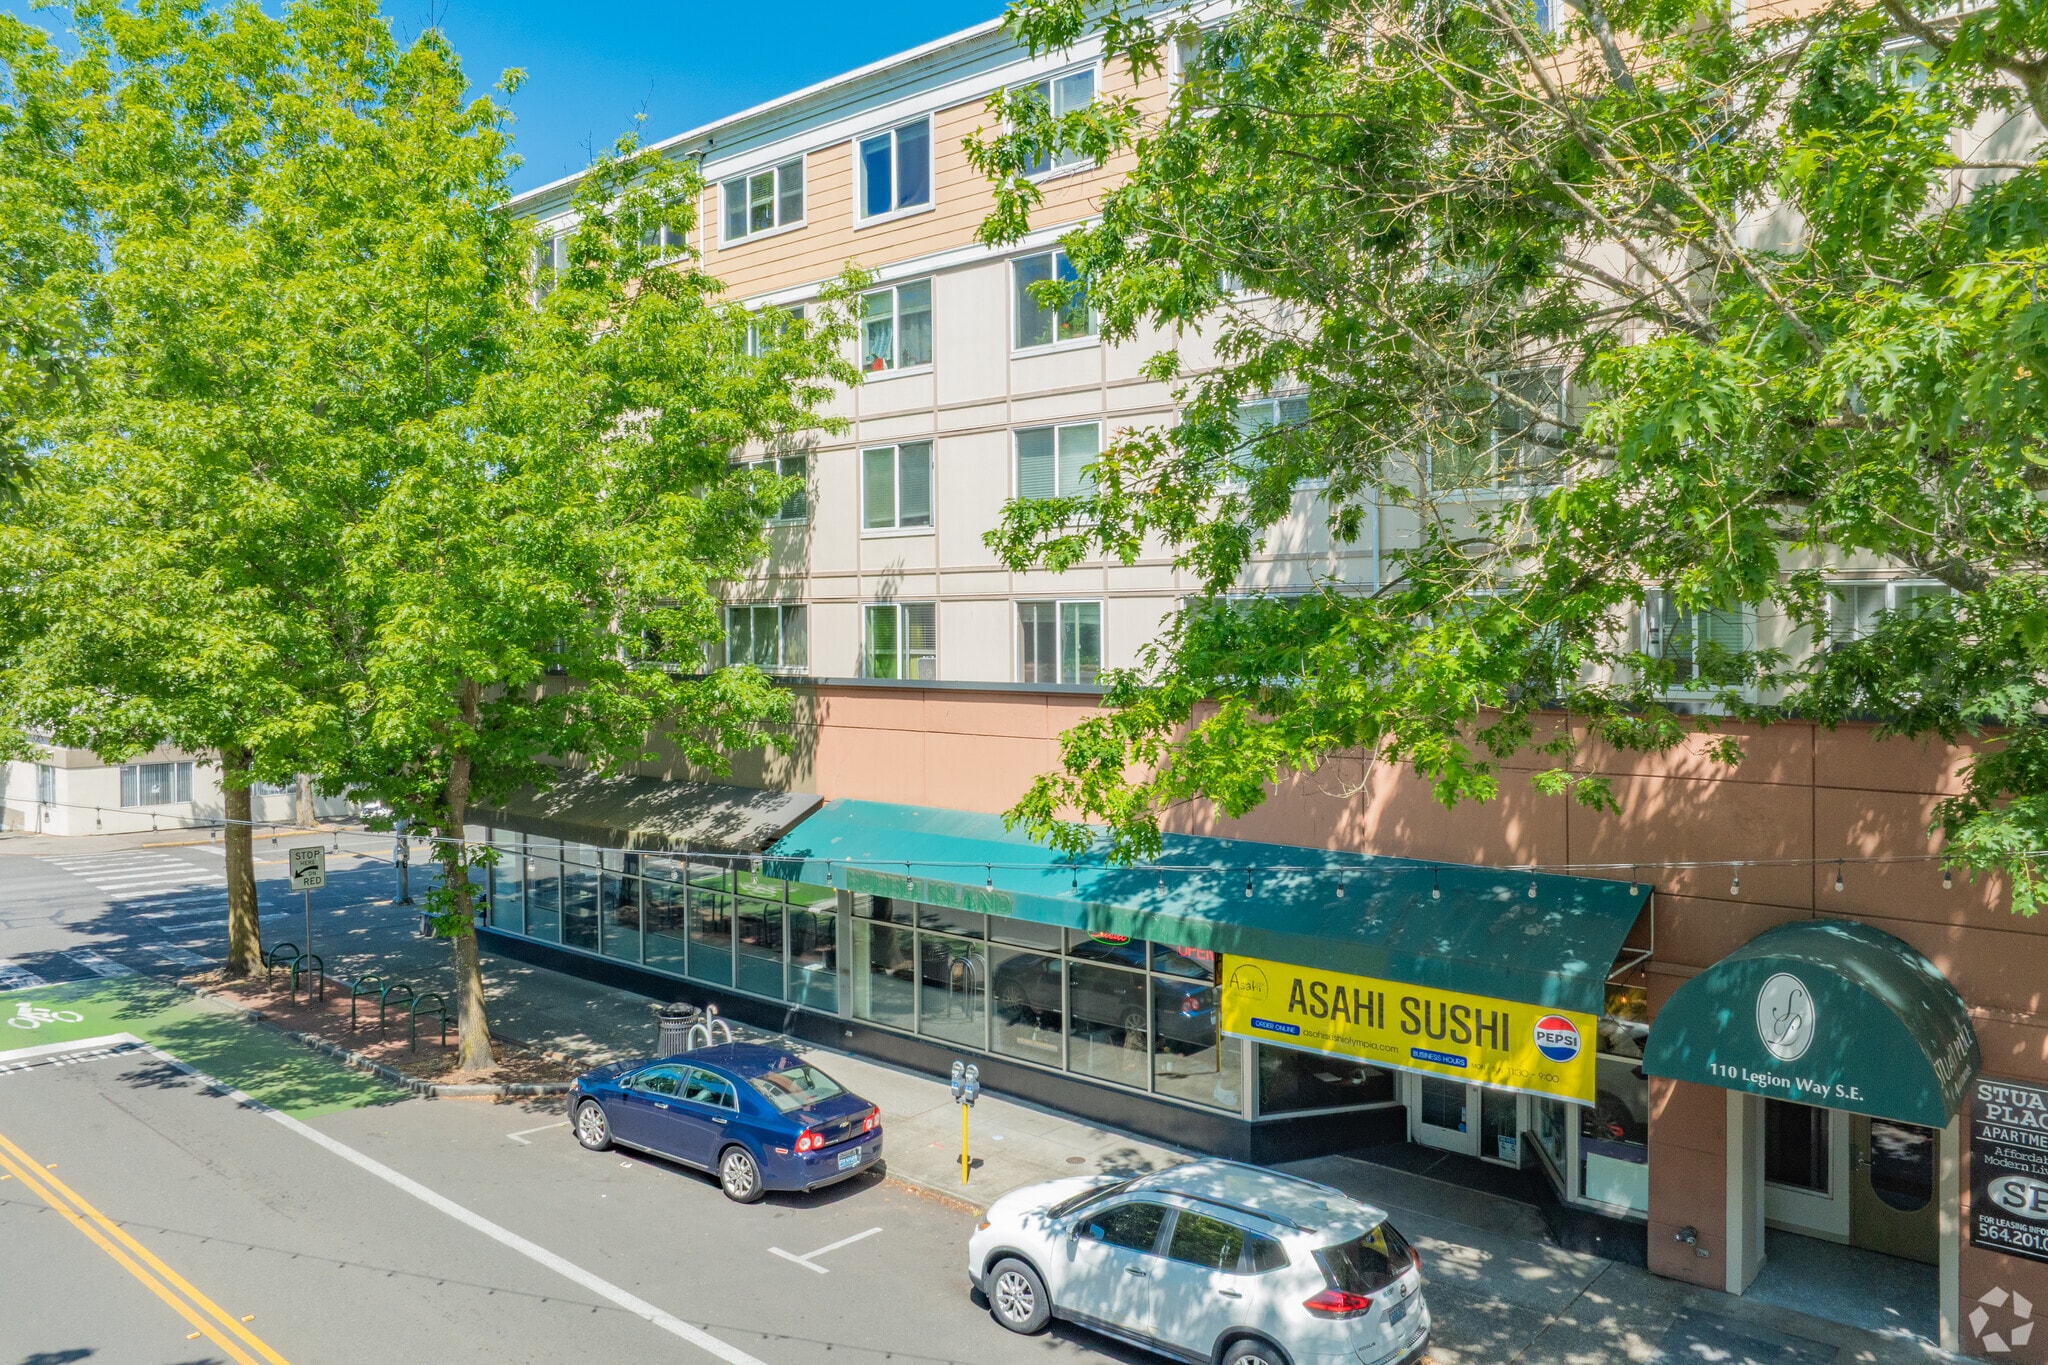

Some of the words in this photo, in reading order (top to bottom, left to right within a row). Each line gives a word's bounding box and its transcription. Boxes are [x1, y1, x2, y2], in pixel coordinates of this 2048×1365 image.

[295, 850, 320, 860] STOP
[303, 876, 321, 886] RED
[1230, 971, 1264, 992] Asahi
[1288, 978, 1384, 1030] ASAHI
[1400, 996, 1509, 1052] SUSHI
[1255, 1020, 1275, 1031] ORDER
[1275, 1024, 1295, 1034] ONLINE
[1303, 1028, 1399, 1053] asahisushiolympia.com
[1536, 1031, 1577, 1047] PEPSI
[1412, 1050, 1441, 1062] BUSINESS
[1442, 1057, 1466, 1067] HOURS
[0, 1060, 33, 1076] IT
[1507, 1067, 1529, 1078] 11:30
[1538, 1072, 1560, 1083] 9:00
[1710, 1063, 1737, 1079] 110
[1742, 1068, 1790, 1088] Legion
[1795, 1077, 1830, 1098] Way
[1835, 1084, 1864, 1101] S.E.
[1977, 1084, 2047, 1111] STUA
[1984, 1154, 2029, 1172] Modern
[1979, 1214, 1994, 1224] FOR
[1996, 1218, 2027, 1232] LEASING
[2029, 1225, 2048, 1237] INFO
